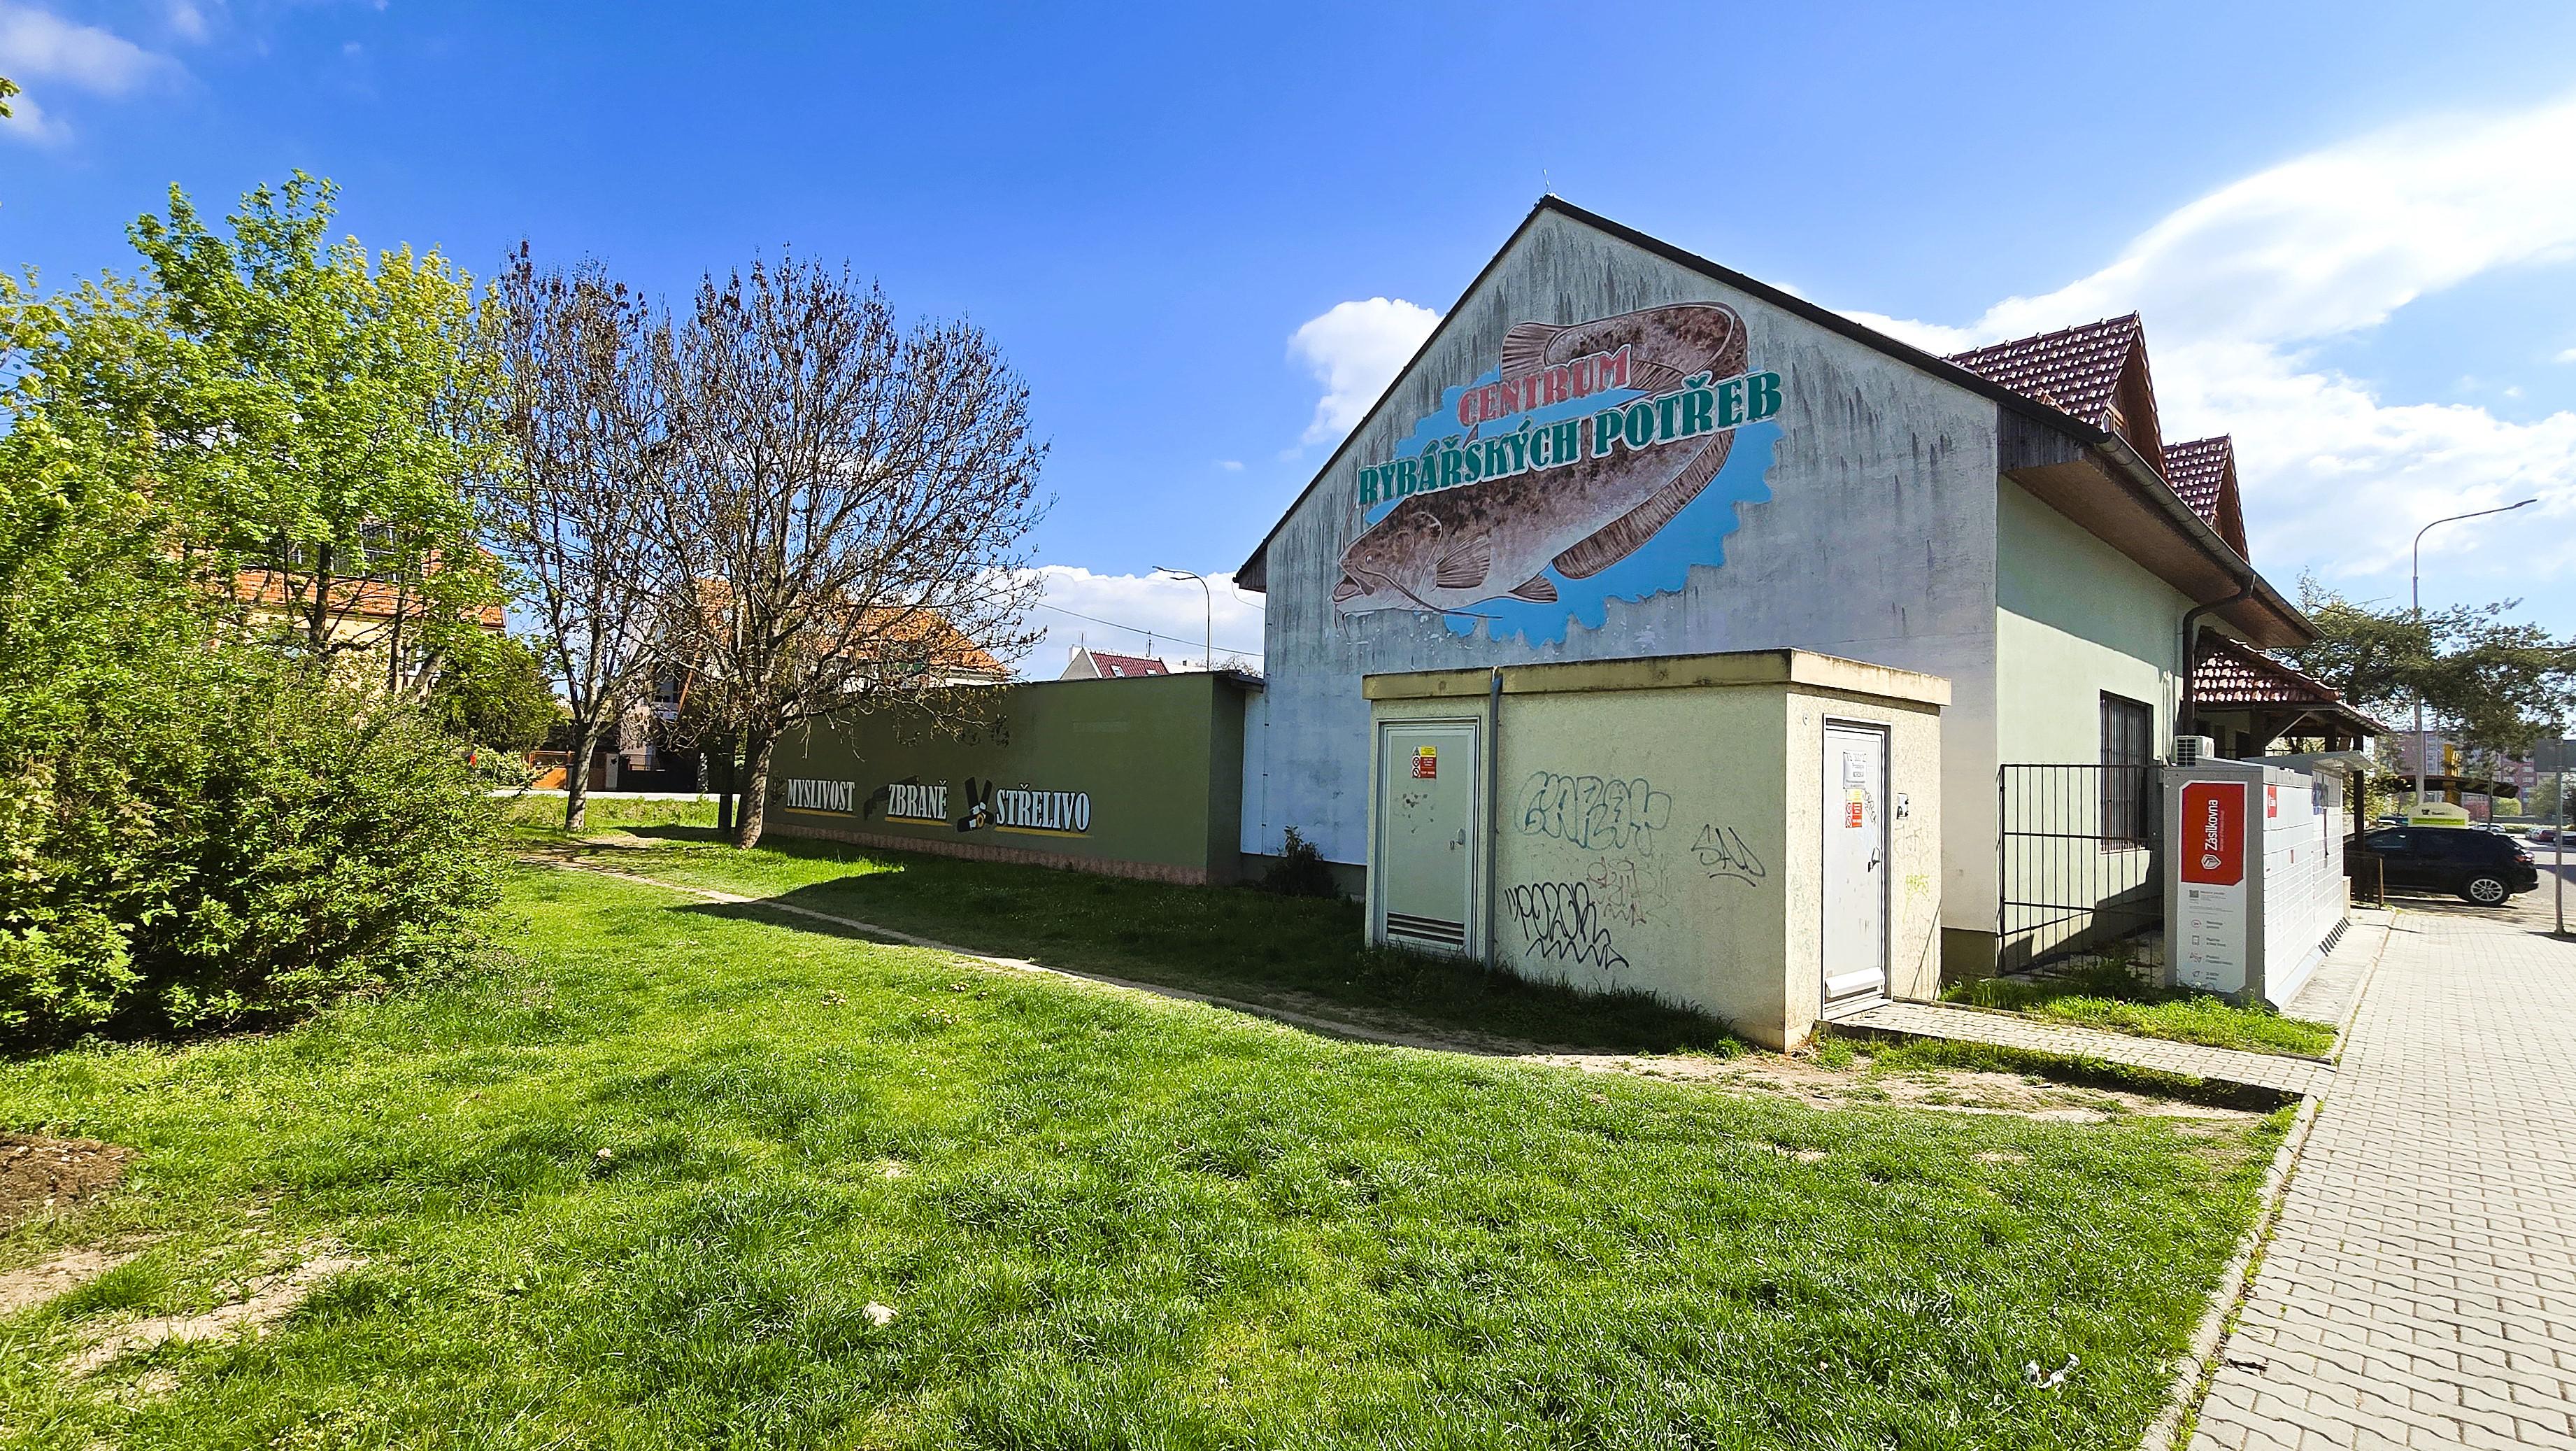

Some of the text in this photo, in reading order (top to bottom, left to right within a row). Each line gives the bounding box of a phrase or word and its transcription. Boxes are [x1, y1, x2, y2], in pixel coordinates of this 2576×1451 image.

[1458, 347, 1629, 425] CENTRUM
[1360, 372, 1781, 504] RYBÁŘSKÝCH POTŘEB
[787, 779, 1091, 830] MYSLIVOST ZBRANĚ STŘELIVO
[2205, 799, 2219, 851] Zásilkovna
